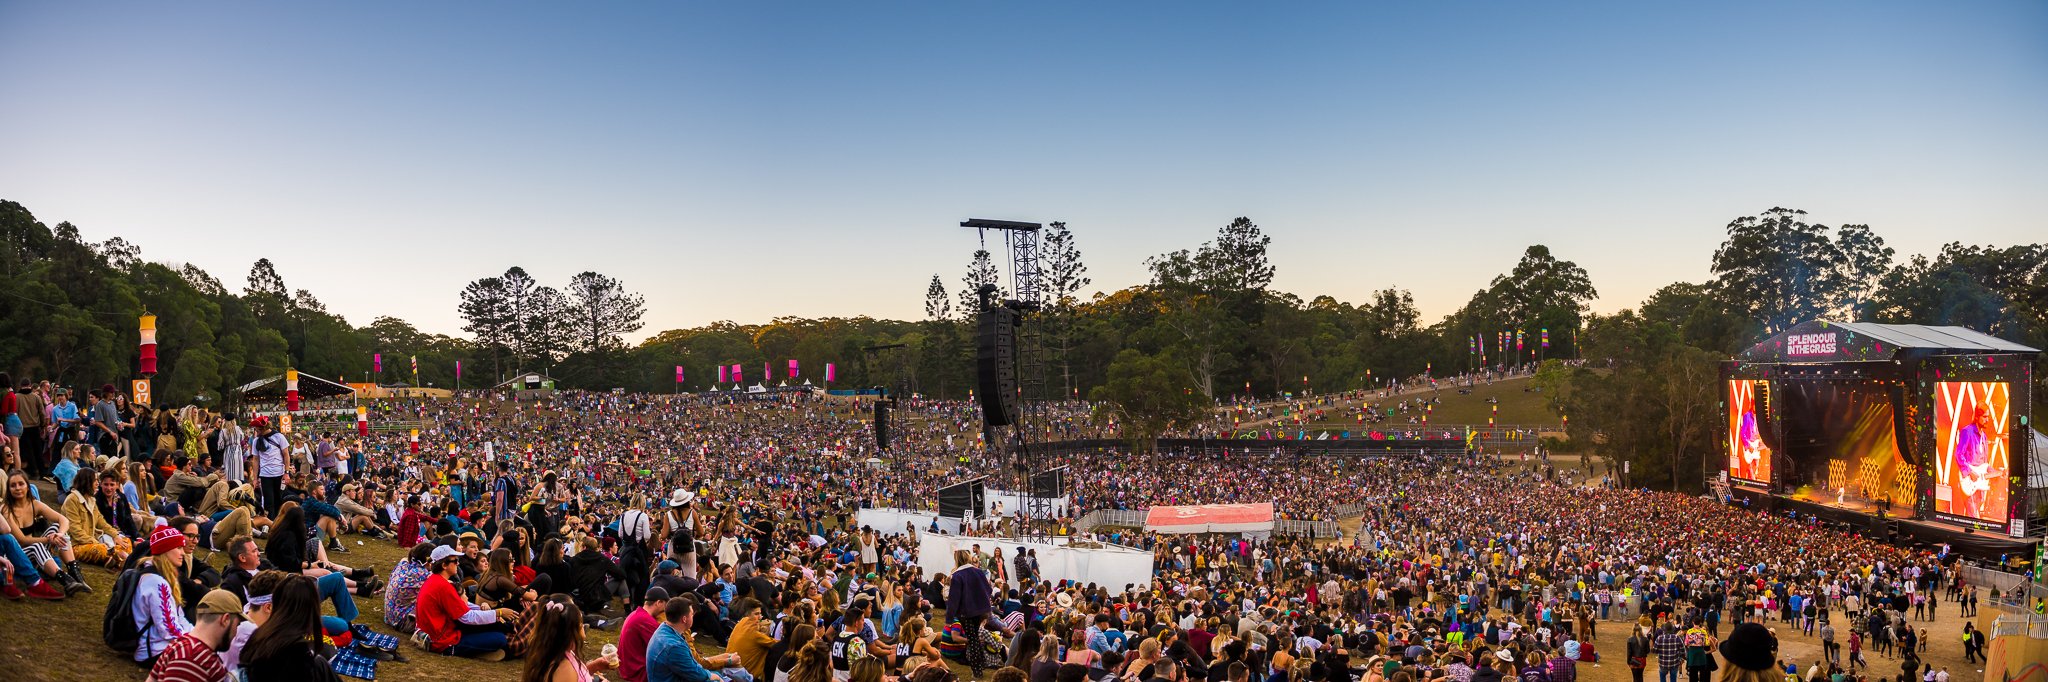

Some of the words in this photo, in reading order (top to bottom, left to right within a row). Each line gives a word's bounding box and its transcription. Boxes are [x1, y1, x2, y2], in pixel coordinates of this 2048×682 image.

[1787, 332, 1836, 345] SPLENDOUR
[136, 381, 148, 393] O
[135, 392, 149, 403] 17
[281, 424, 292, 433] 16
[832, 641, 845, 658] GK
[896, 642, 910, 656] GA
